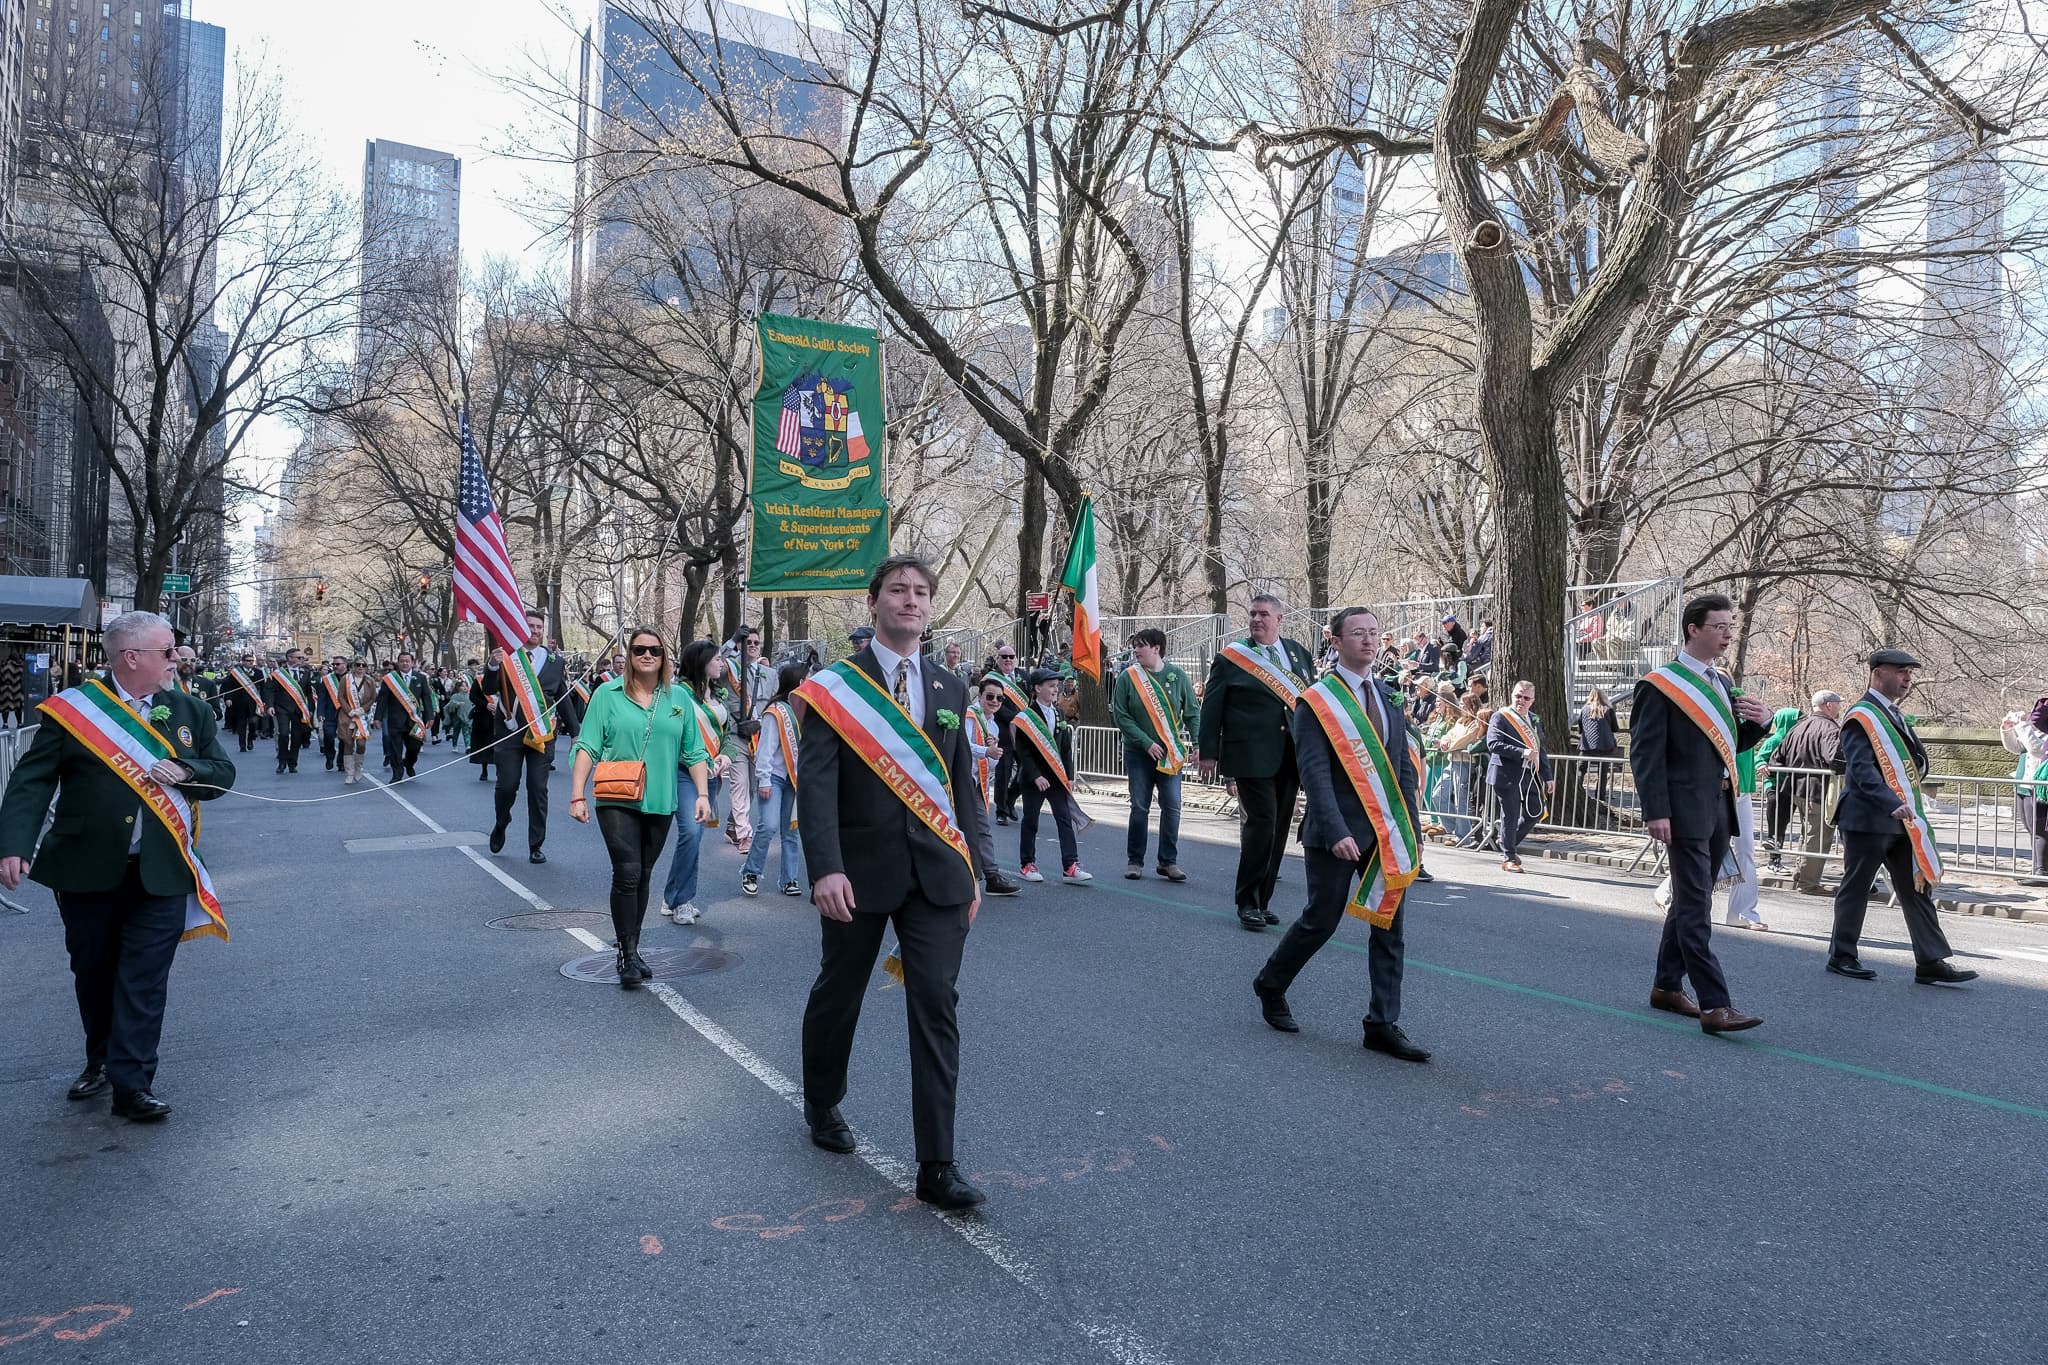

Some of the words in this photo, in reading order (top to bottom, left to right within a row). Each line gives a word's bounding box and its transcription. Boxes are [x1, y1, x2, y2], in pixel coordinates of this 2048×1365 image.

[767, 329, 810, 349] Emerald
[812, 337, 834, 352] Guild
[837, 341, 870, 358] Society
[765, 503, 790, 516] Irish
[792, 504, 836, 519] Resident
[837, 506, 881, 519] Managers
[780, 520, 789, 532] &
[791, 521, 870, 536] Superintendents
[784, 539, 794, 550] of
[796, 539, 819, 551] New
[821, 540, 844, 551] York
[1143, 680, 1165, 721] MARSHAL
[1253, 666, 1297, 704] EMERALD
[1350, 738, 1377, 776] AIDE
[1871, 731, 1899, 789] EMERALD
[1903, 759, 1918, 789] AIDE
[111, 752, 181, 827] EMERALD
[875, 755, 955, 840] EMERALD
